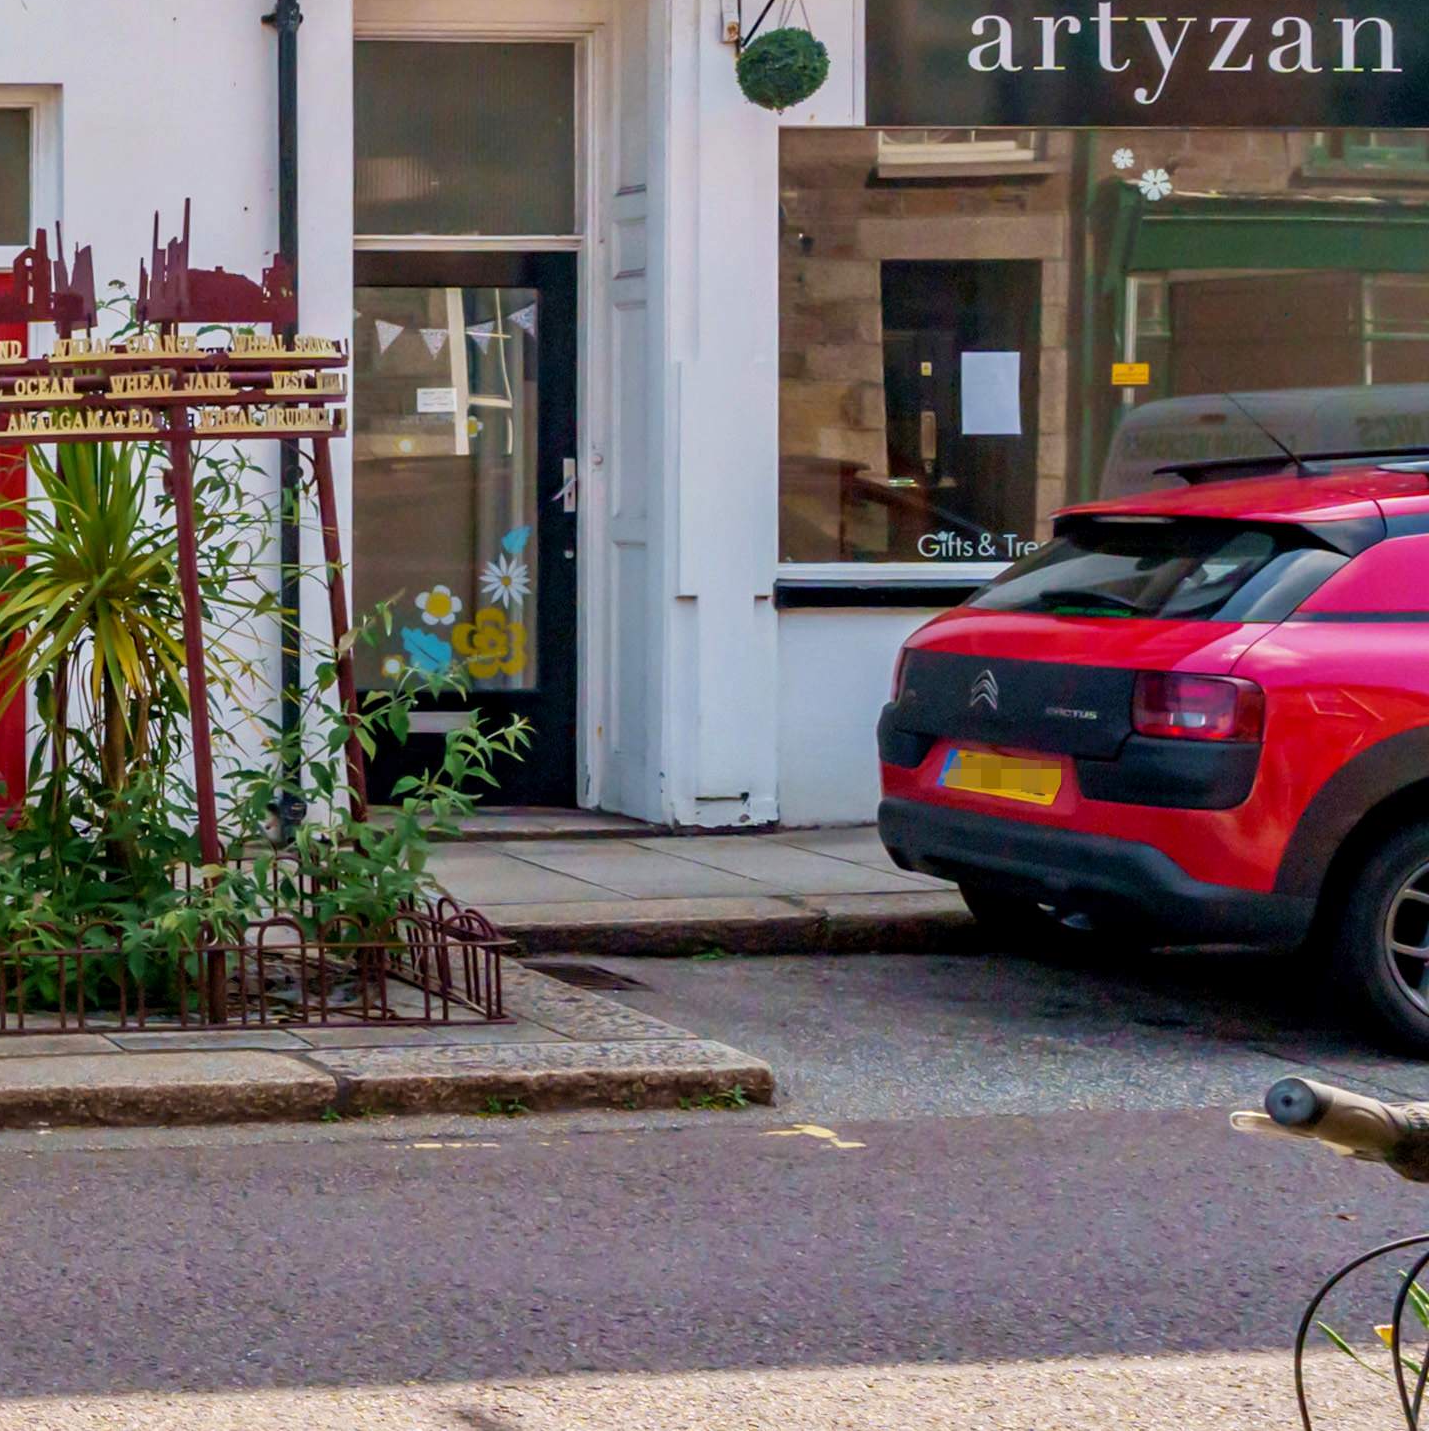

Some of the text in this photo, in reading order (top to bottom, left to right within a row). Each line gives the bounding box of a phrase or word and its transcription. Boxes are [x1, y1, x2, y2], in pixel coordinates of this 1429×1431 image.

[967, 1, 1403, 105] artyzan
[52, 337, 117, 357] WHEAL
[235, 334, 287, 352] WHEAL
[14, 376, 75, 396] OCEAN
[109, 373, 173, 393] WHEAL
[183, 371, 231, 390] JANE
[271, 371, 307, 389] WEST
[7, 410, 154, 433] AMALGAMATED
[917, 531, 1047, 557] Gifts & Tre
